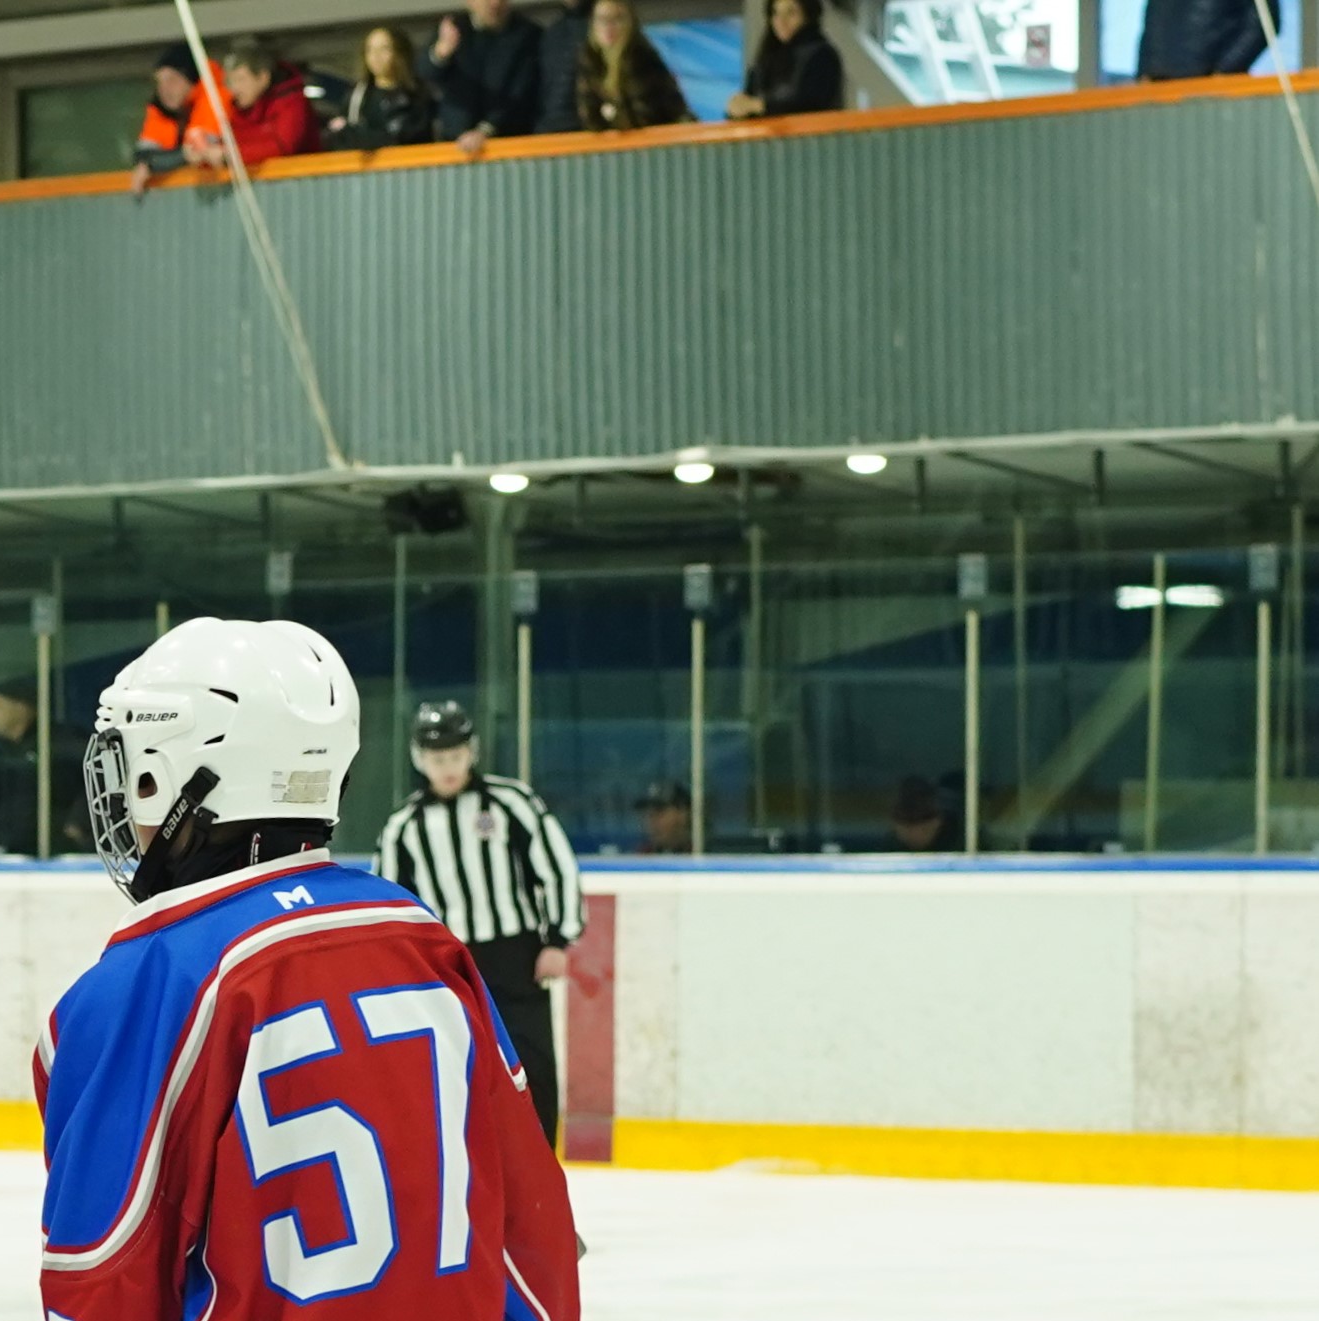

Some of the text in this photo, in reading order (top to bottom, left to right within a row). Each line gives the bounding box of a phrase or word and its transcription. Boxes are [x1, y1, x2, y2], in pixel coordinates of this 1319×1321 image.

[135, 712, 179, 722] BAUER
[162, 798, 190, 841] BAUE
[235, 981, 477, 1307] 57
